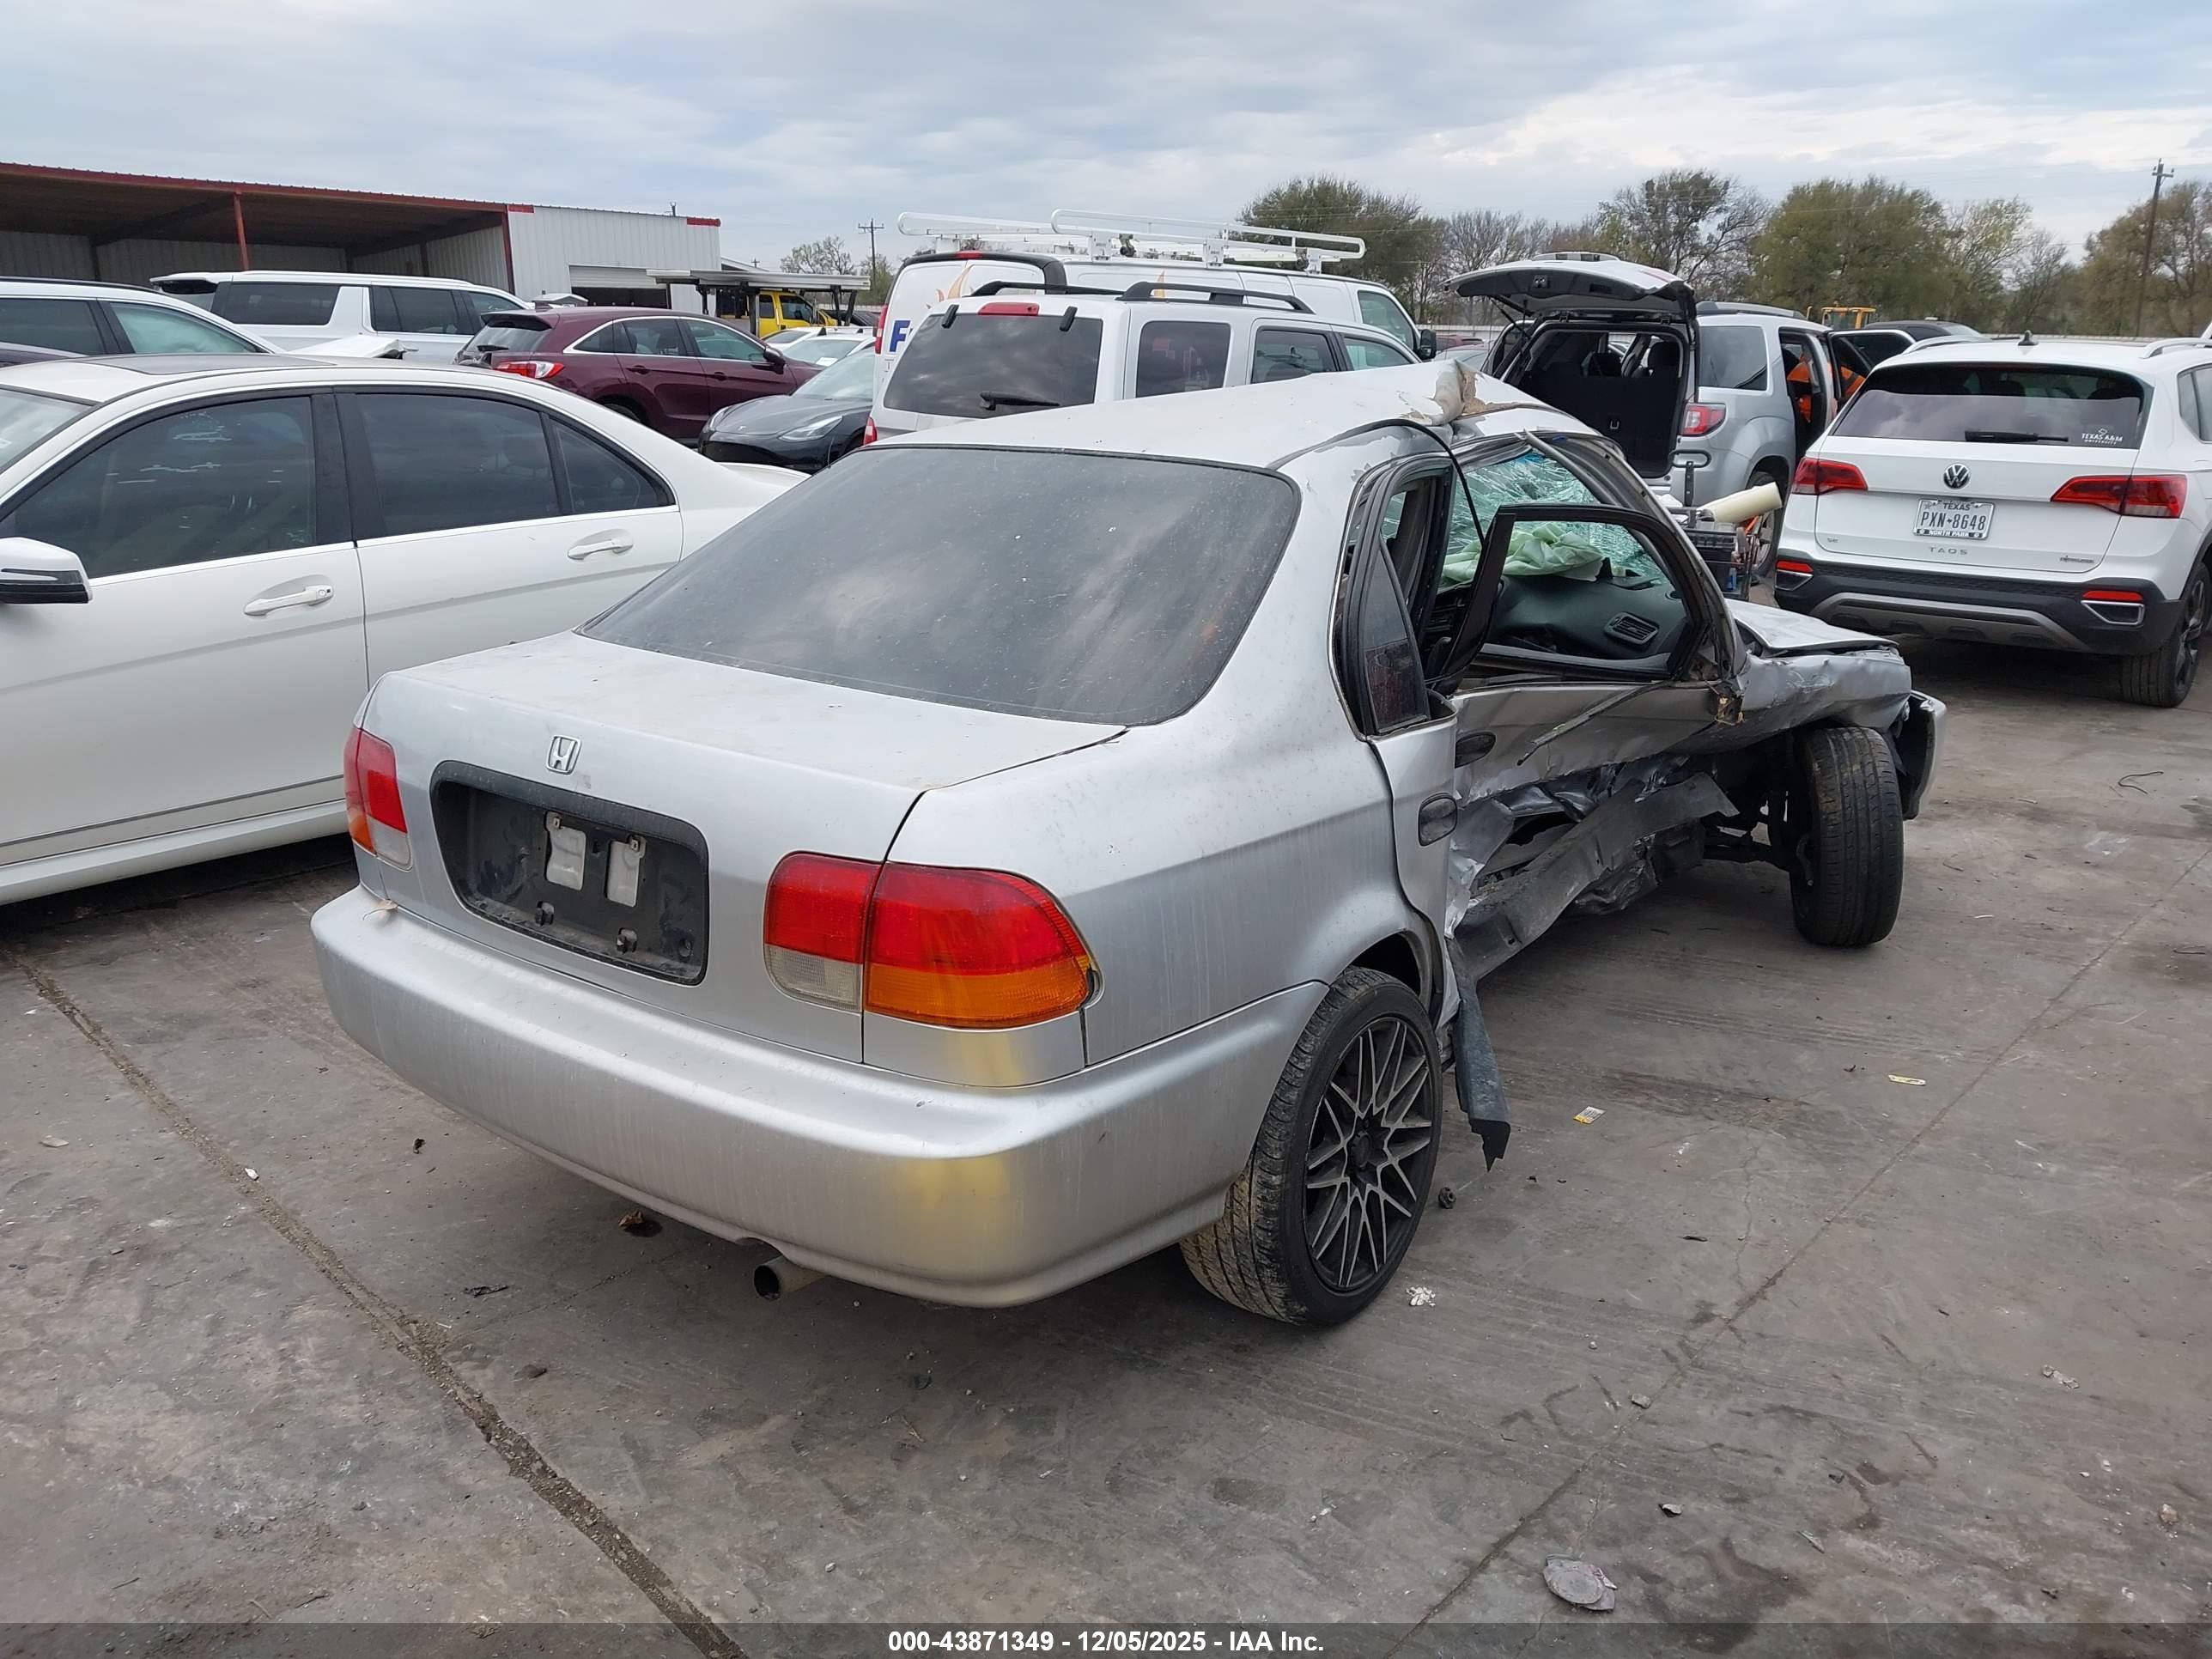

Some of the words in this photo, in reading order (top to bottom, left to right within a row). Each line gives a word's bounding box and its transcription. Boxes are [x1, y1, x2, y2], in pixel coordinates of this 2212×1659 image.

[889, 319, 913, 352] F
[1943, 502, 1971, 511] TEXAS
[1929, 547, 1968, 556] TAOS
